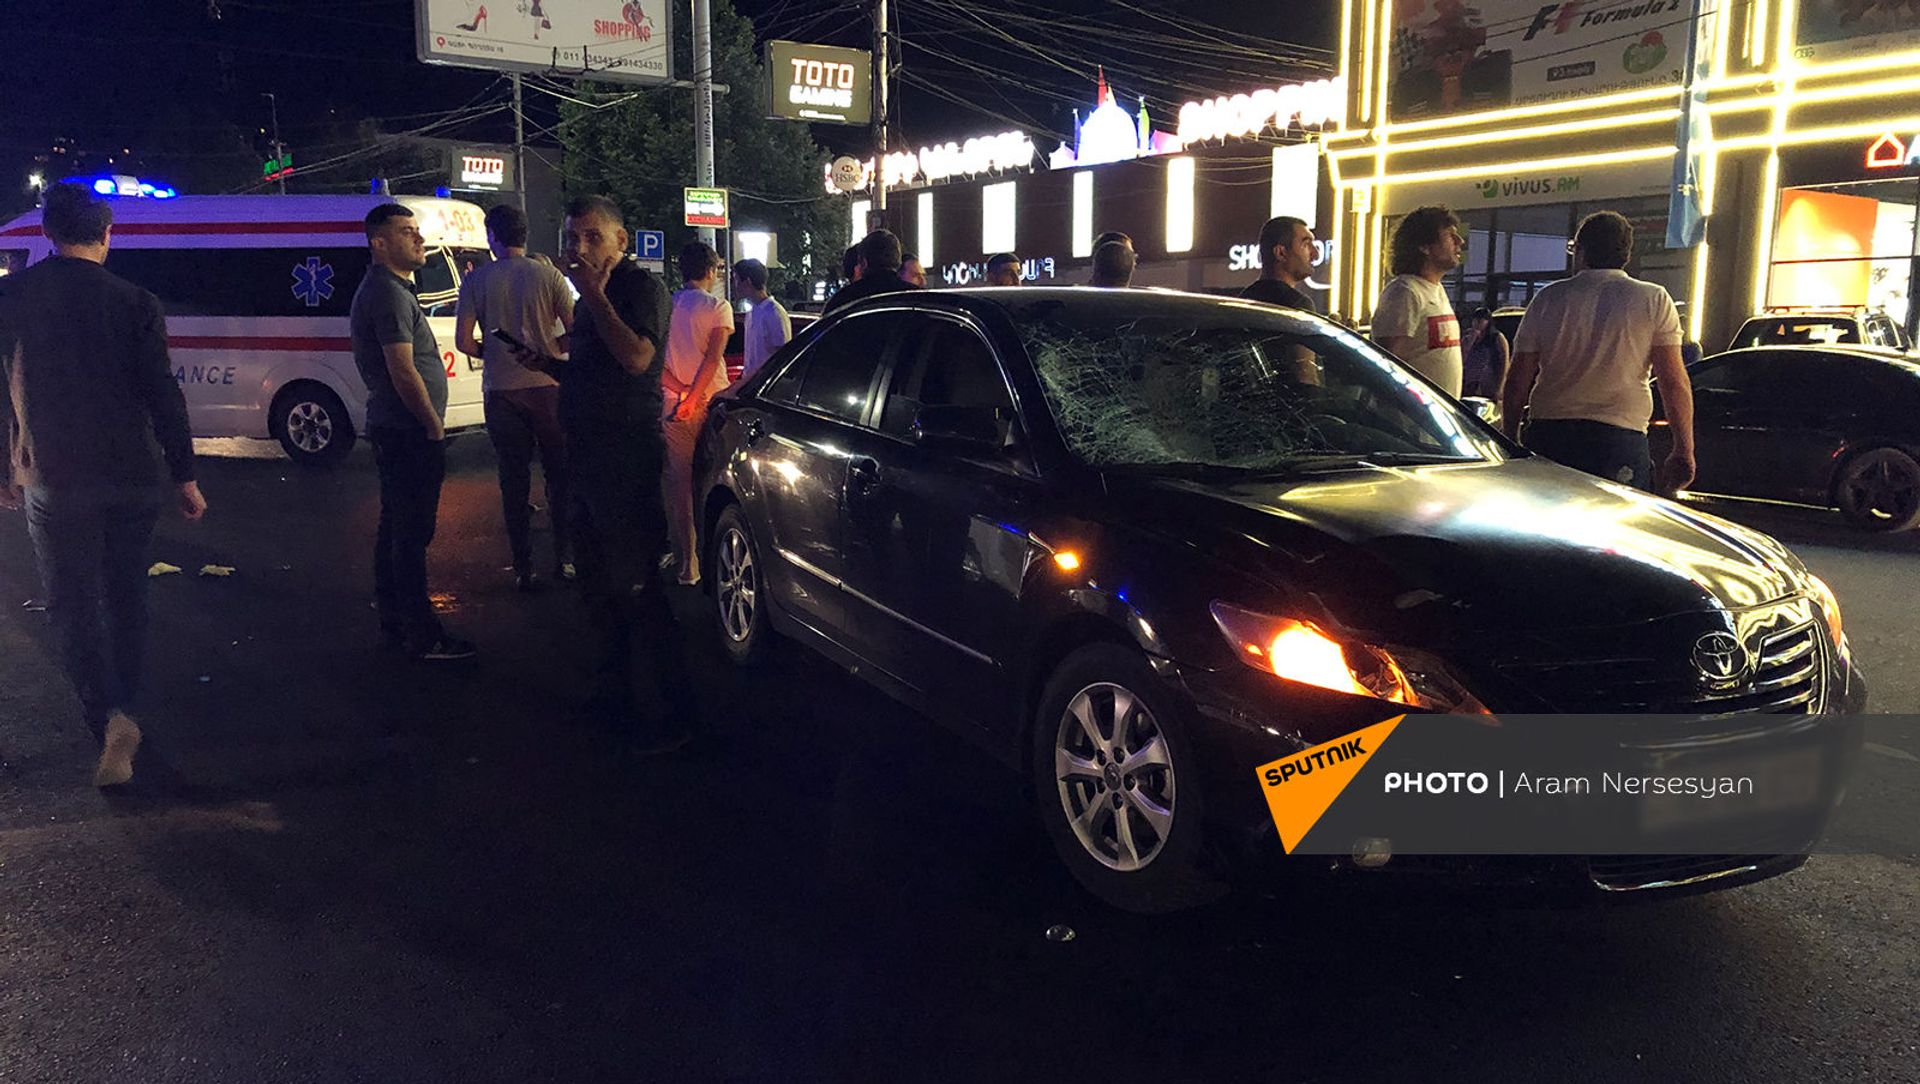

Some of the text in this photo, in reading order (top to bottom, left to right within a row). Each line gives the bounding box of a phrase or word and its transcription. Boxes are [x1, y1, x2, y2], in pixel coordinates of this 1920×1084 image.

[563, 51, 580, 61] 011
[791, 58, 855, 89] TOTO
[462, 156, 503, 174] TOTO
[643, 233, 659, 257] P
